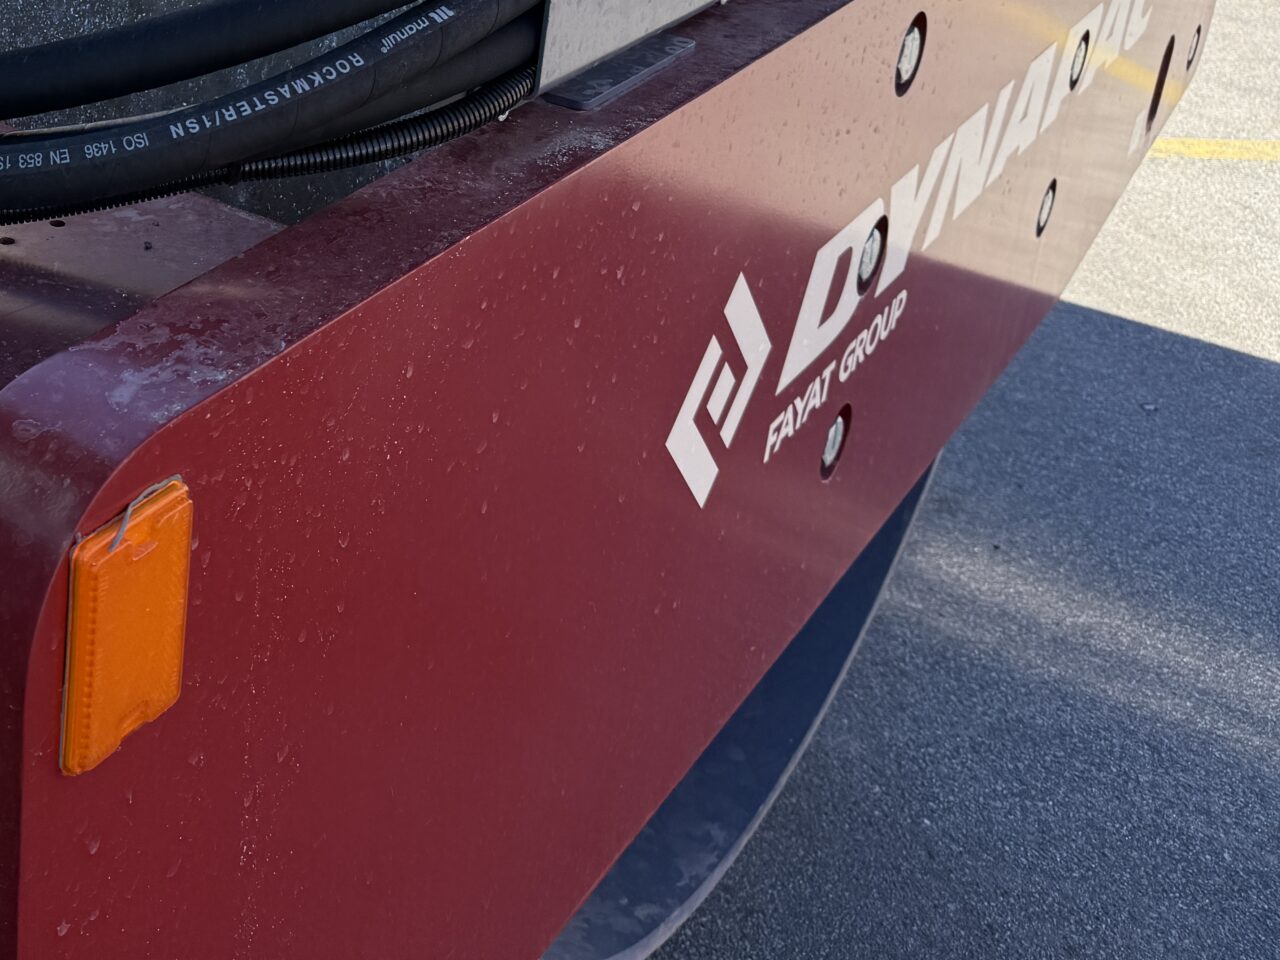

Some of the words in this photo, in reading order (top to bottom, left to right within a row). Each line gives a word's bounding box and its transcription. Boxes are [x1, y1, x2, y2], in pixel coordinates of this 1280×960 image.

[169, 52, 365, 139] ROCKMASTER/1SN
[84, 141, 117, 159] 1436
[123, 132, 149, 151] ISO
[19, 152, 43, 169] 853
[49, 149, 70, 165] EN
[763, 360, 836, 464] FAYAT
[838, 289, 908, 383] GROUP
